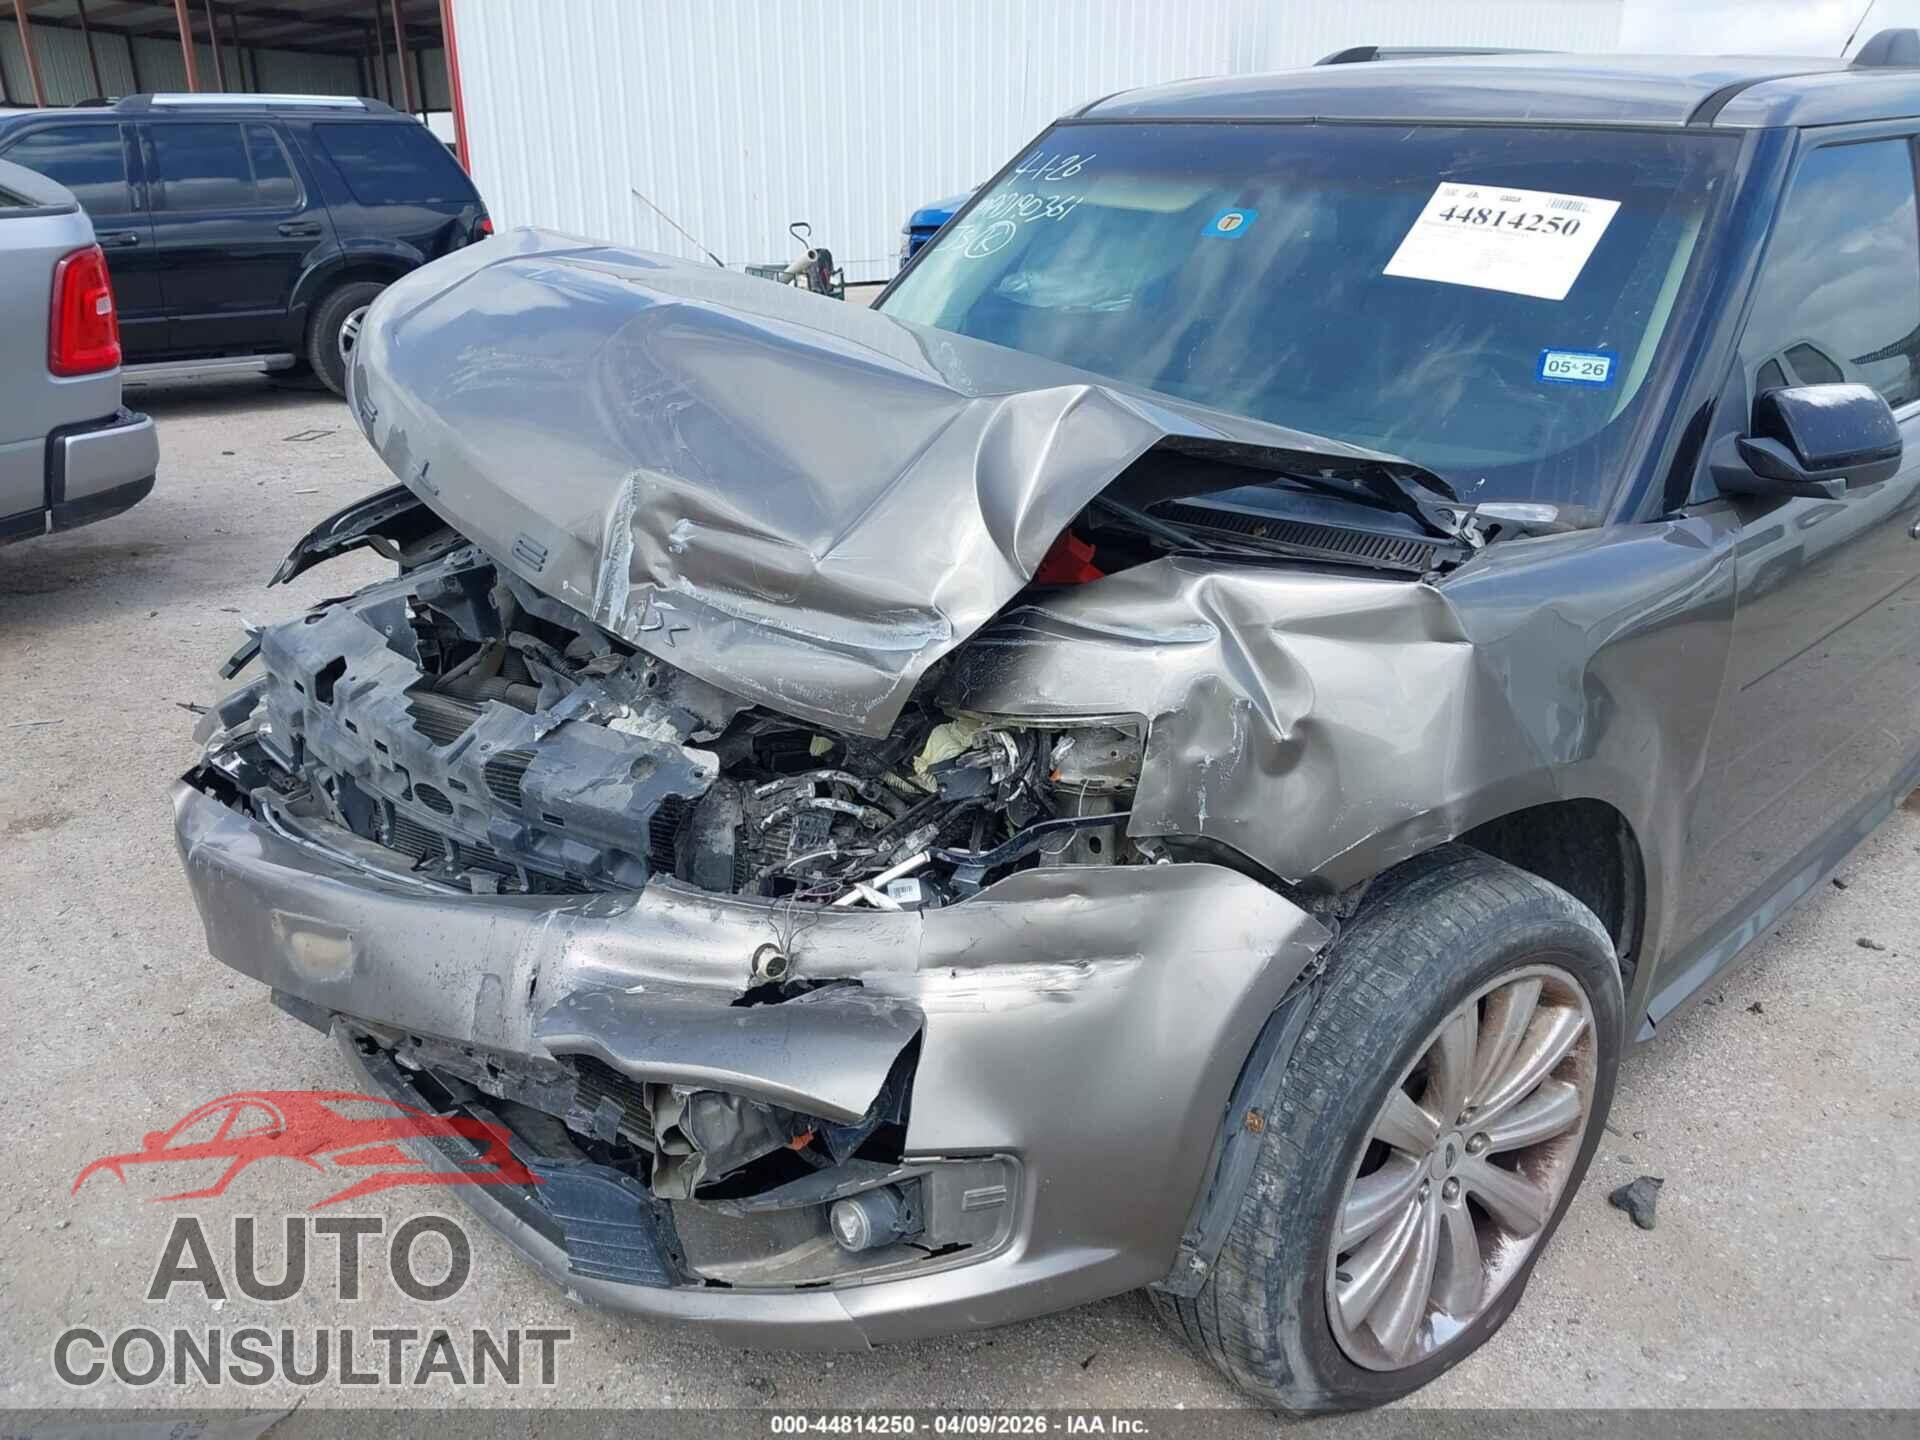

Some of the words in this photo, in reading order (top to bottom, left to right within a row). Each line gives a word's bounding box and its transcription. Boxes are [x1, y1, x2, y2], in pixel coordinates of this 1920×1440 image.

[1439, 204, 1581, 237] 44814250
[1548, 360, 1571, 373] 05
[1582, 362, 1605, 376] 26
